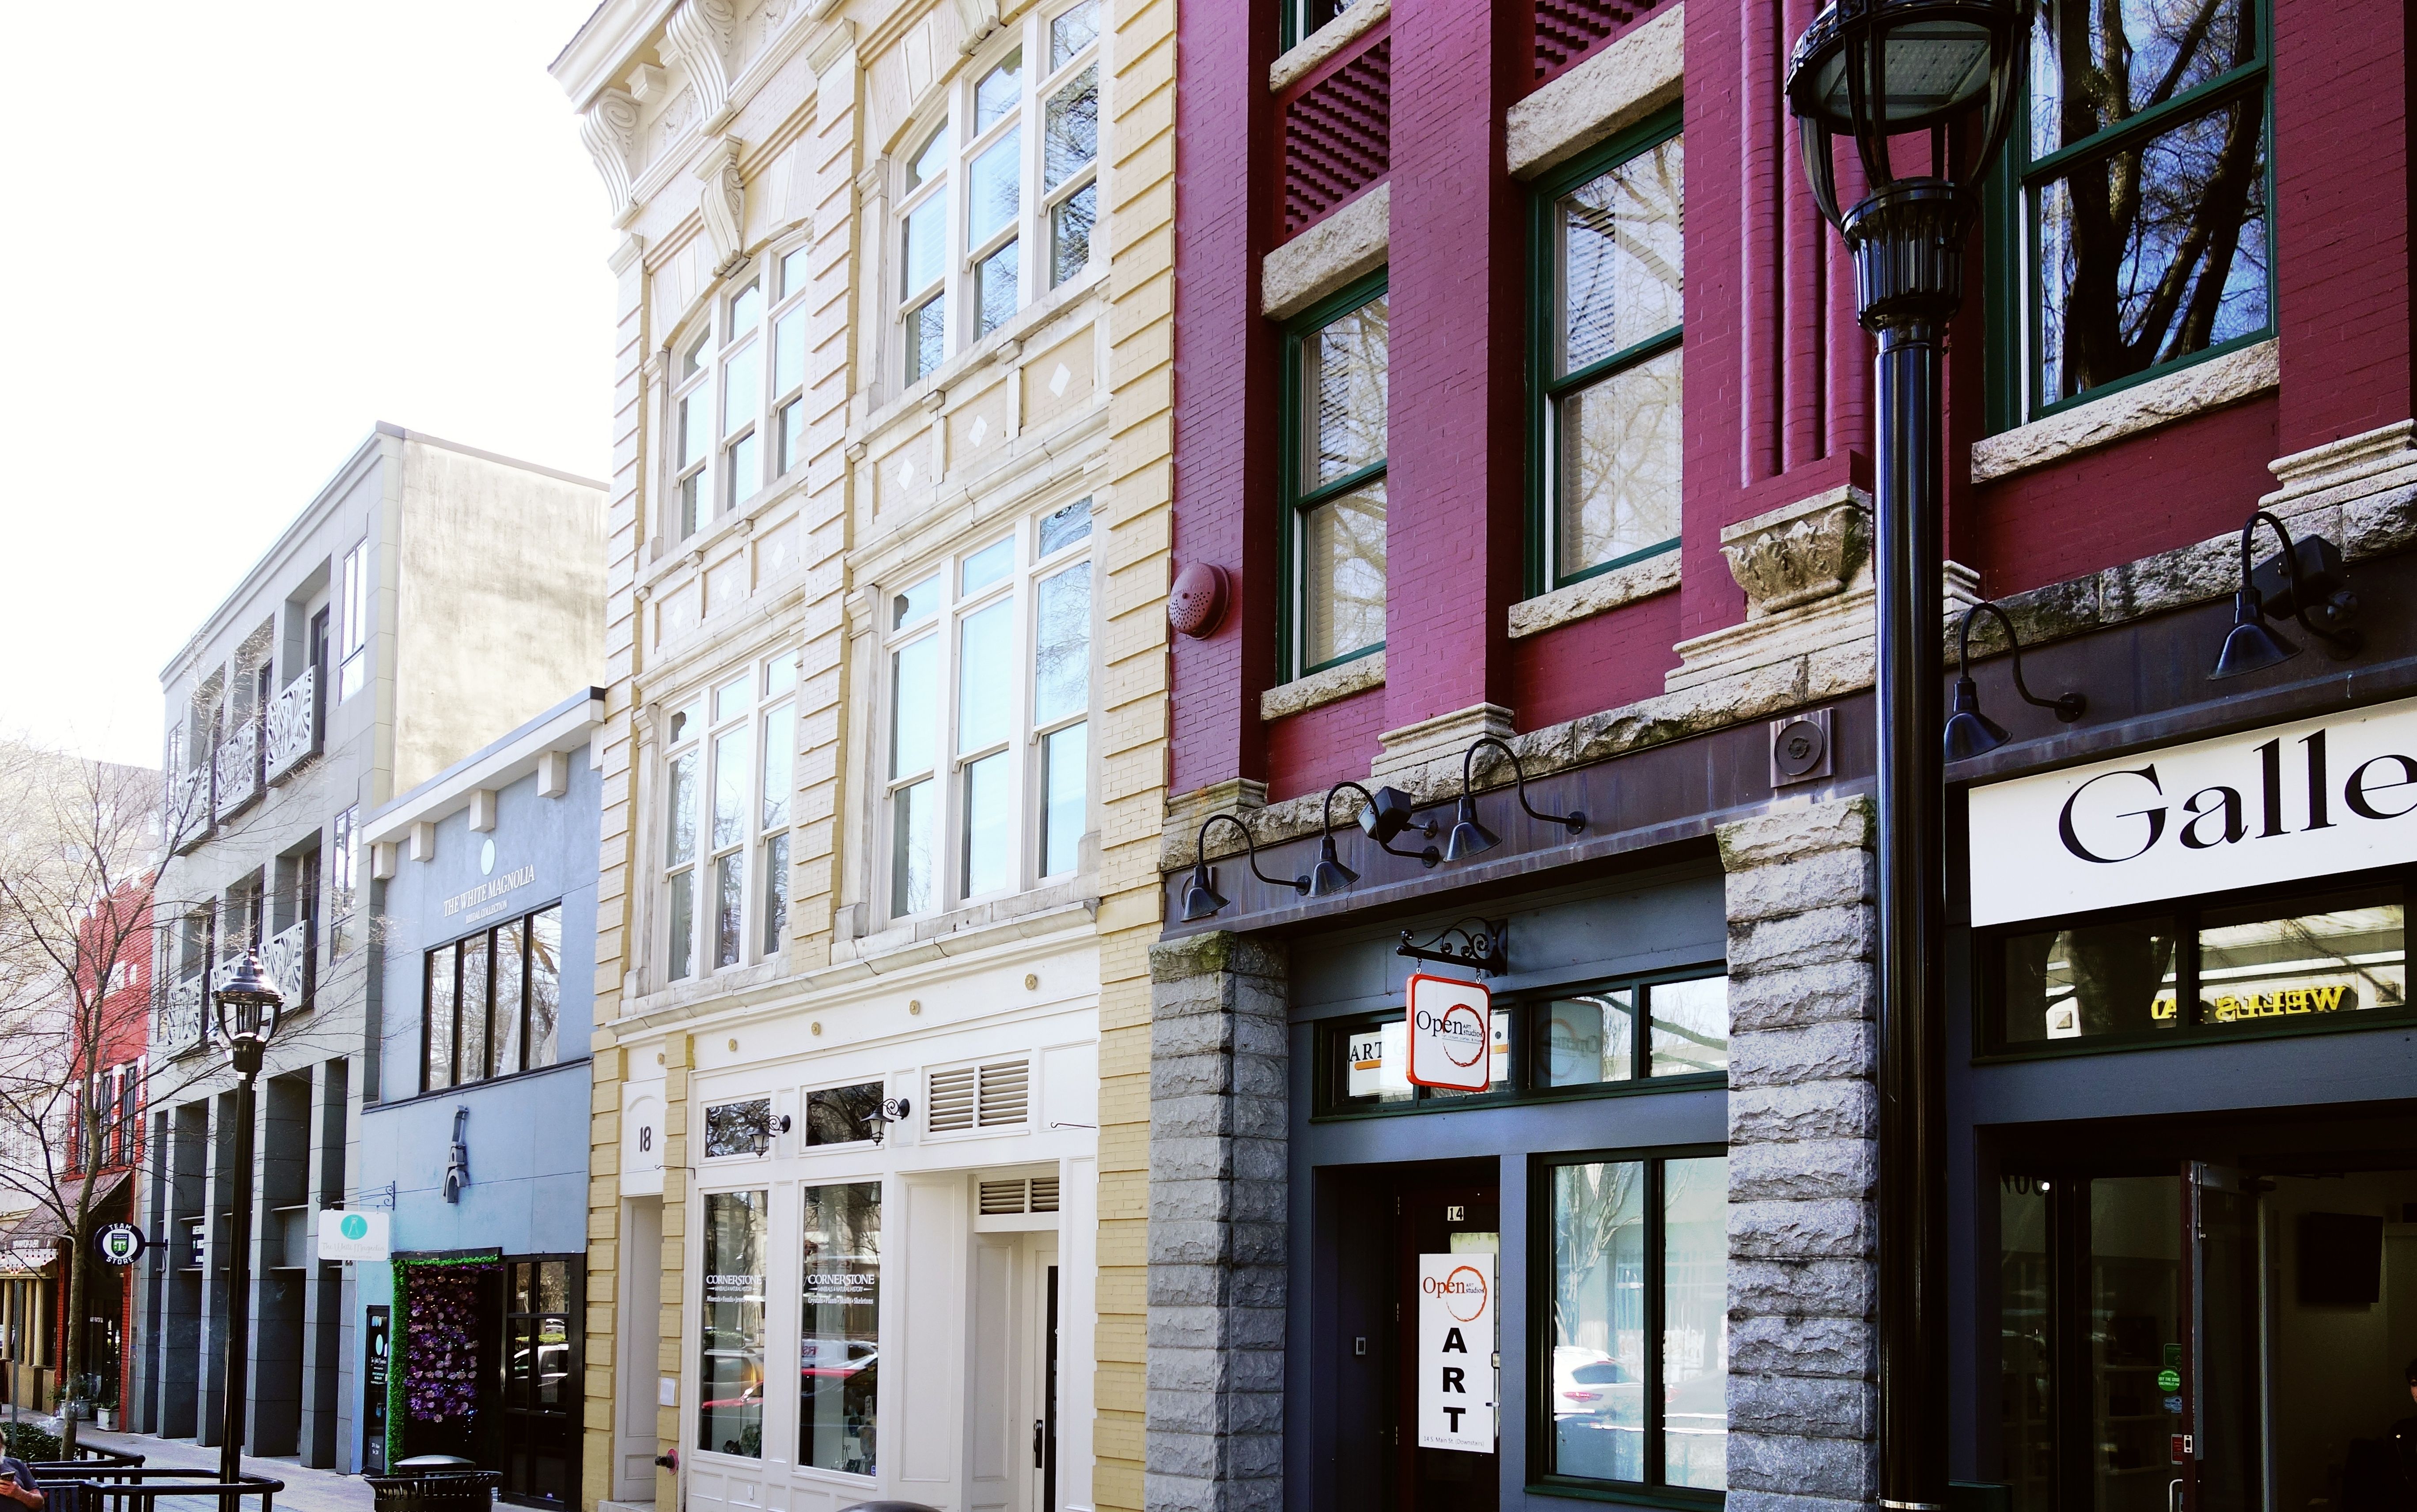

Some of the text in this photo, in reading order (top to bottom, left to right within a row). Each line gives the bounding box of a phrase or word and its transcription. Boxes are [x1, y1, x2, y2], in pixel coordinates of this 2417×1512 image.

[2058, 728, 2417, 864] Galle
[443, 864, 535, 917] THE WHITE MAGNOLIA
[466, 899, 508, 924] BRIDAL COLLECTION
[1416, 1010, 1463, 1037] Open
[1349, 1041, 1382, 1062] ART
[639, 1126, 651, 1153] 18
[1450, 1207, 1463, 1220] 14
[321, 1242, 333, 1251] The
[334, 1242, 352, 1252] White
[106, 1256, 134, 1265] STORE
[706, 1274, 762, 1286] CORNERSTONE
[808, 1274, 875, 1286] CORNERSTONE
[1423, 1277, 1465, 1299] Open
[808, 1297, 823, 1305] Crystals
[1442, 1327, 1468, 1433] ART
